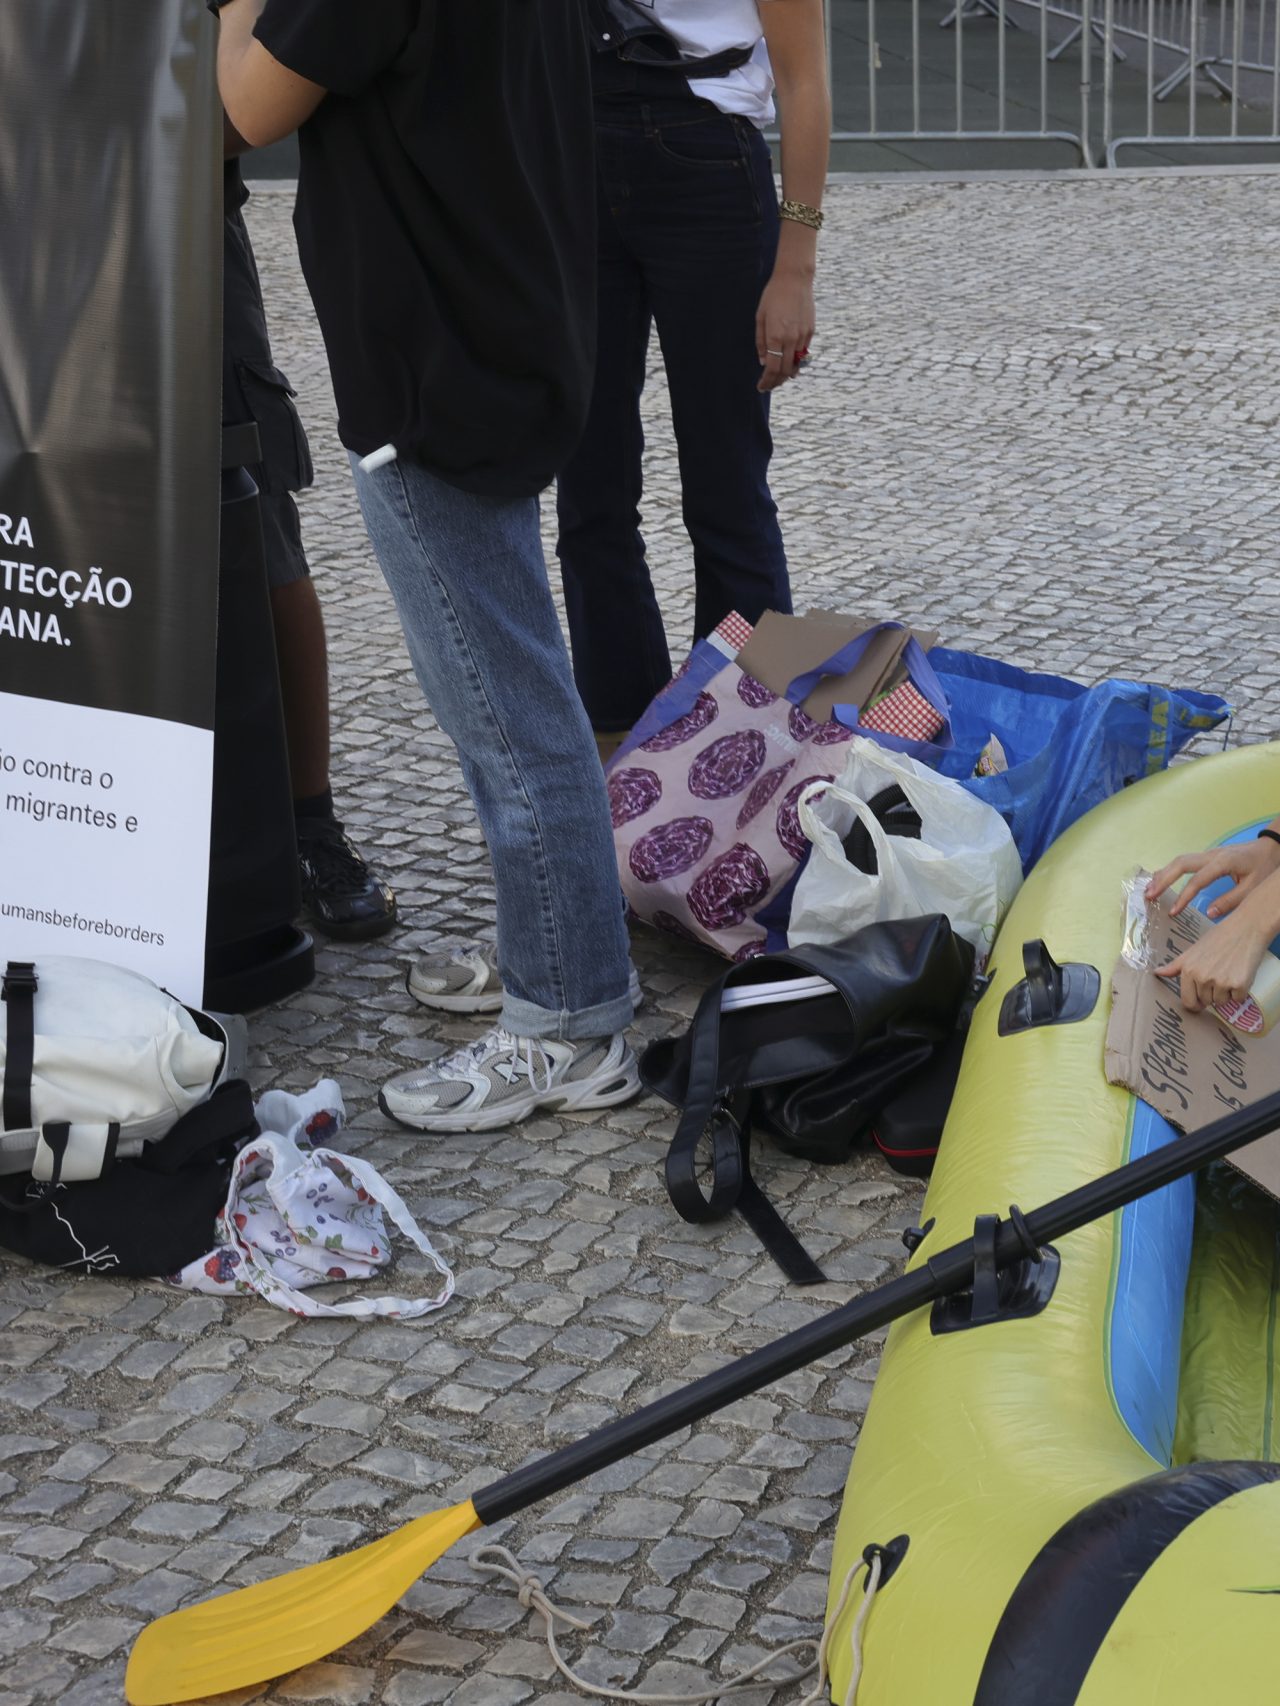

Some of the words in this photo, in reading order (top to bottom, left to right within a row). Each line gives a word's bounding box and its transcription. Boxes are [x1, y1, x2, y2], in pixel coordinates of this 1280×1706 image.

[0, 559, 134, 610] TECÇÃO
[0, 606, 73, 648] ANA.
[23, 757, 93, 787] contra
[99, 771, 115, 791] o
[6, 792, 118, 830] migrantes
[124, 814, 139, 834] e
[0, 901, 166, 947] umansbeforeborders
[1141, 1000, 1194, 1110] SPEAKING
